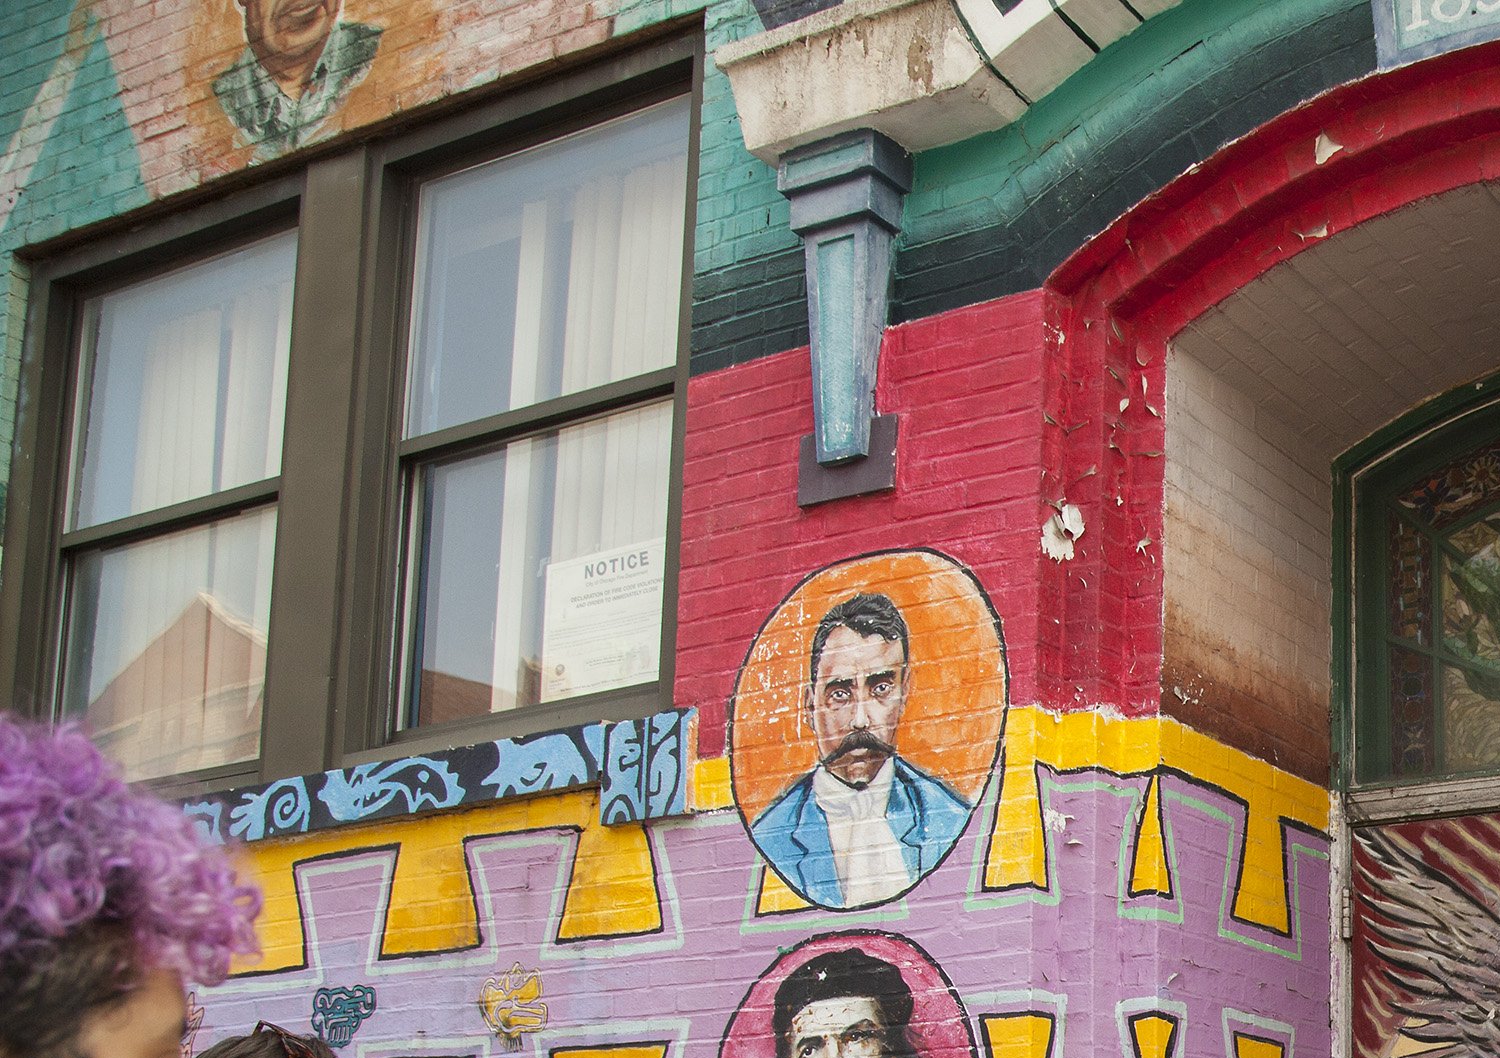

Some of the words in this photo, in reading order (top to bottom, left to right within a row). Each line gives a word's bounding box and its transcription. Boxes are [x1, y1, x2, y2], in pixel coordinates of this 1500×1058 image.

[584, 550, 650, 579] NOTICE
[570, 590, 603, 603] DECLARATION
[612, 586, 622, 594] FIRE
[623, 583, 636, 591] CODE
[612, 590, 642, 602] IMMEDIATELY
[642, 585, 658, 594] CLOSE
